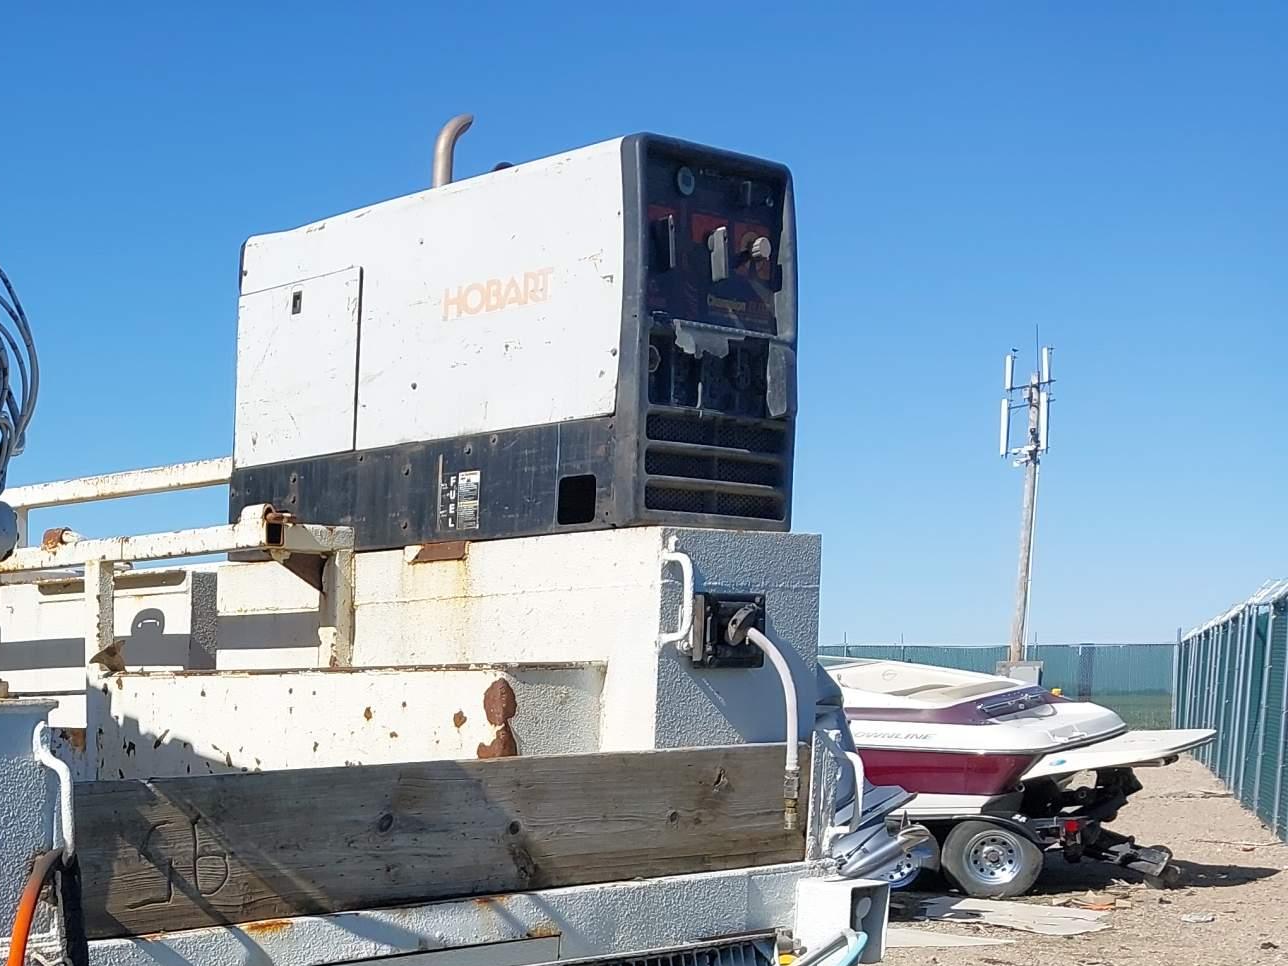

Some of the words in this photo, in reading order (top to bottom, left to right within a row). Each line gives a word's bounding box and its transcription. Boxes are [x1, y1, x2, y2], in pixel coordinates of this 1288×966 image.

[443, 266, 554, 321] HOBART
[448, 475, 457, 527] FUEL
[854, 731, 936, 740] OWNLINE
